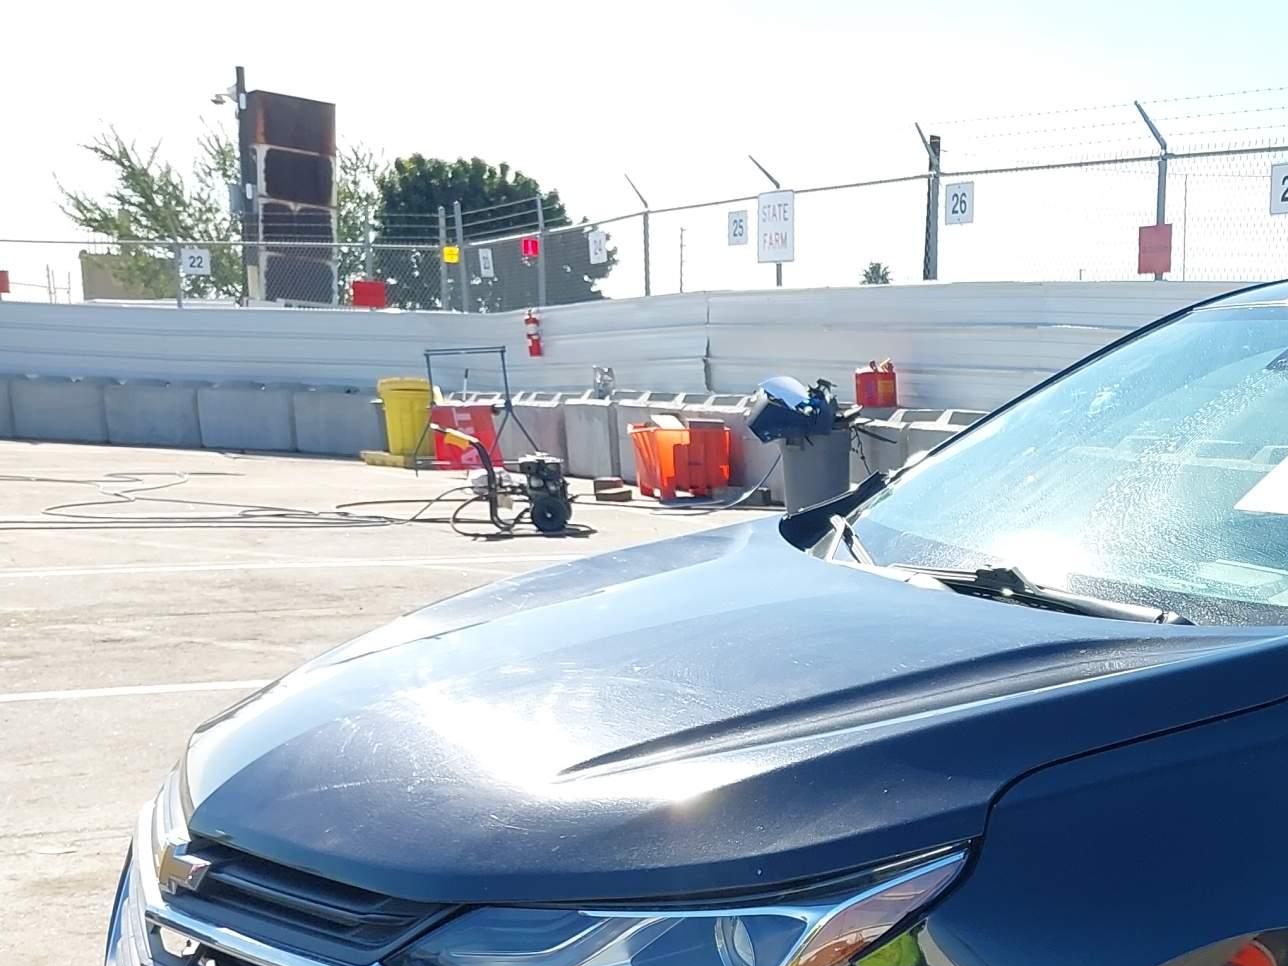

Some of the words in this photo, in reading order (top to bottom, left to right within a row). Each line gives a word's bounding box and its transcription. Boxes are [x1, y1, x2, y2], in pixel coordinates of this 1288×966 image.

[762, 203, 789, 222] STATE
[951, 192, 967, 215] 26
[732, 219, 744, 238] 25
[763, 231, 788, 250] FARM
[188, 255, 204, 269] 22
